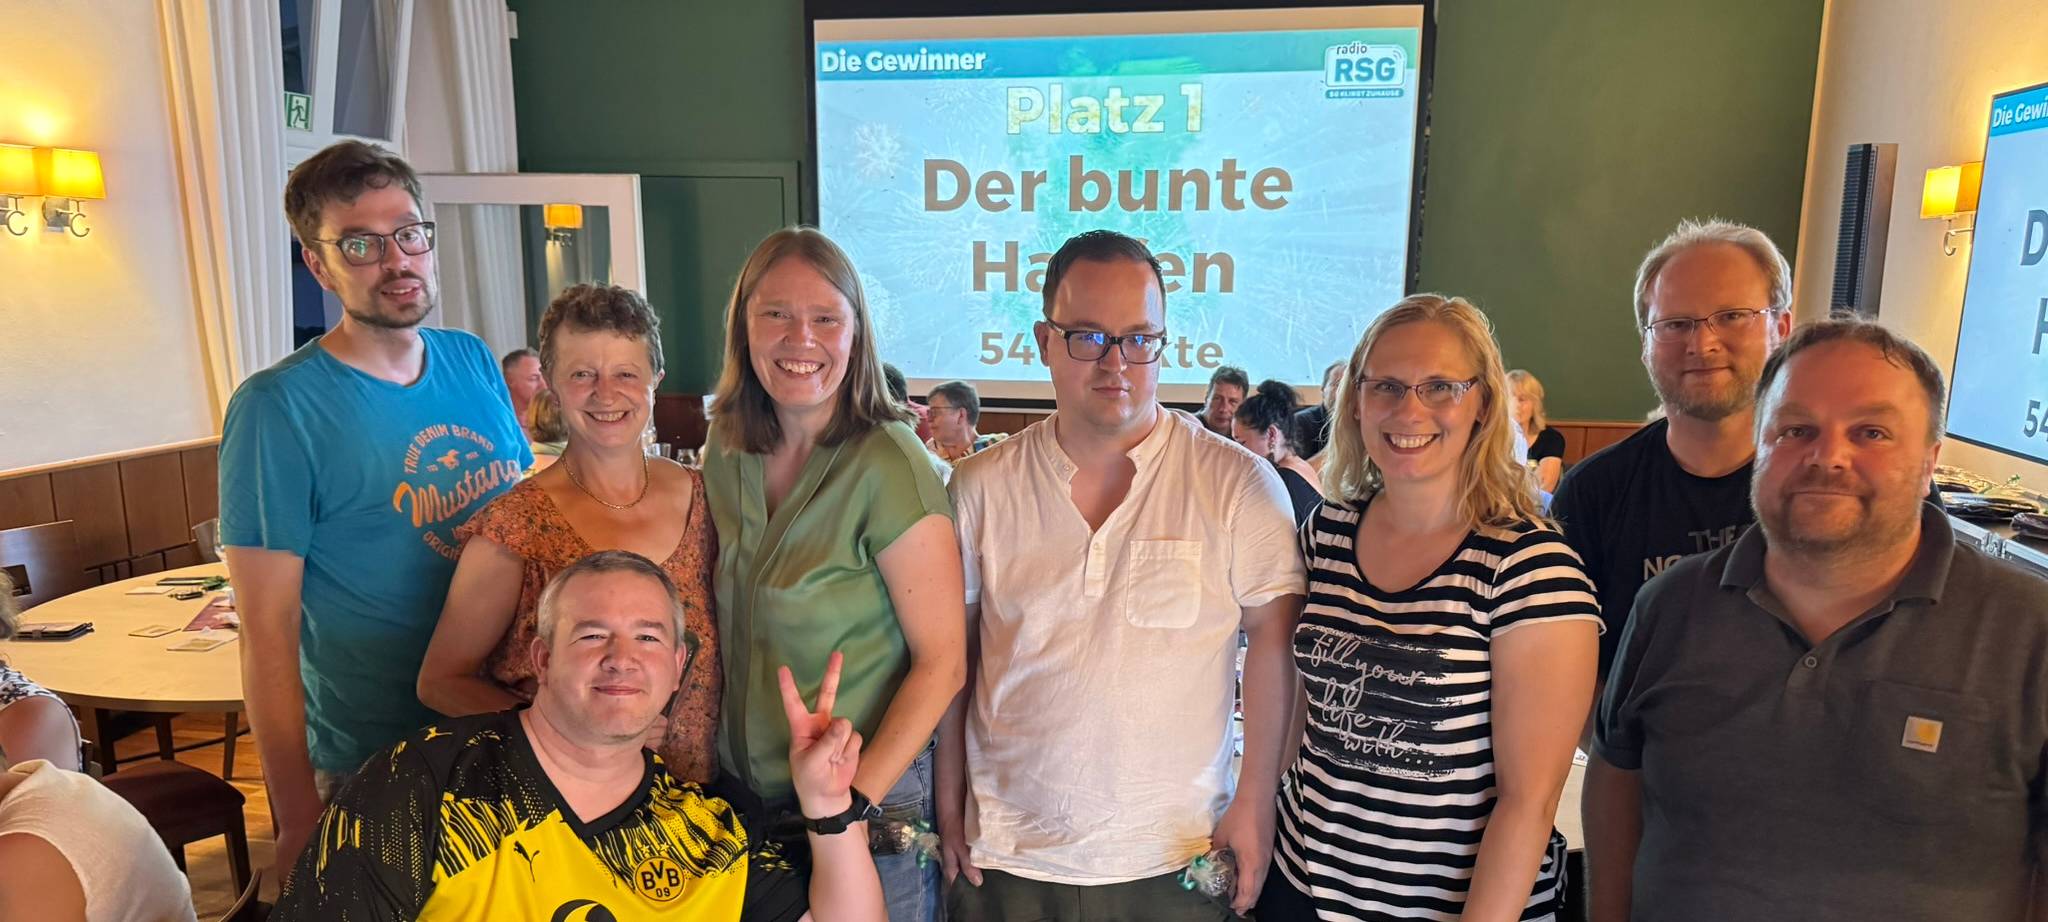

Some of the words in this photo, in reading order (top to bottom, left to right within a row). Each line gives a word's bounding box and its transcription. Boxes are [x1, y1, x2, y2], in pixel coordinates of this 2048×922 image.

[821, 48, 862, 72] Die
[865, 47, 986, 72] Gewinner
[1336, 43, 1368, 55] radio
[1334, 57, 1396, 82] RSG
[1006, 82, 1165, 135] Platz
[1180, 82, 1204, 133] 1
[1992, 104, 2013, 128] Die
[2015, 96, 2048, 123] Gewi
[923, 158, 1047, 213] Der
[1069, 155, 1294, 212] bunte
[979, 332, 1035, 366] 54
[404, 443, 421, 474] TRUE
[414, 424, 450, 448] DENIM
[451, 424, 494, 452] BRAND
[1311, 633, 1361, 668] fill
[1343, 658, 1426, 710] your
[1322, 677, 1373, 741] life
[641, 859, 681, 890] BVB
[656, 887, 671, 898] 09
